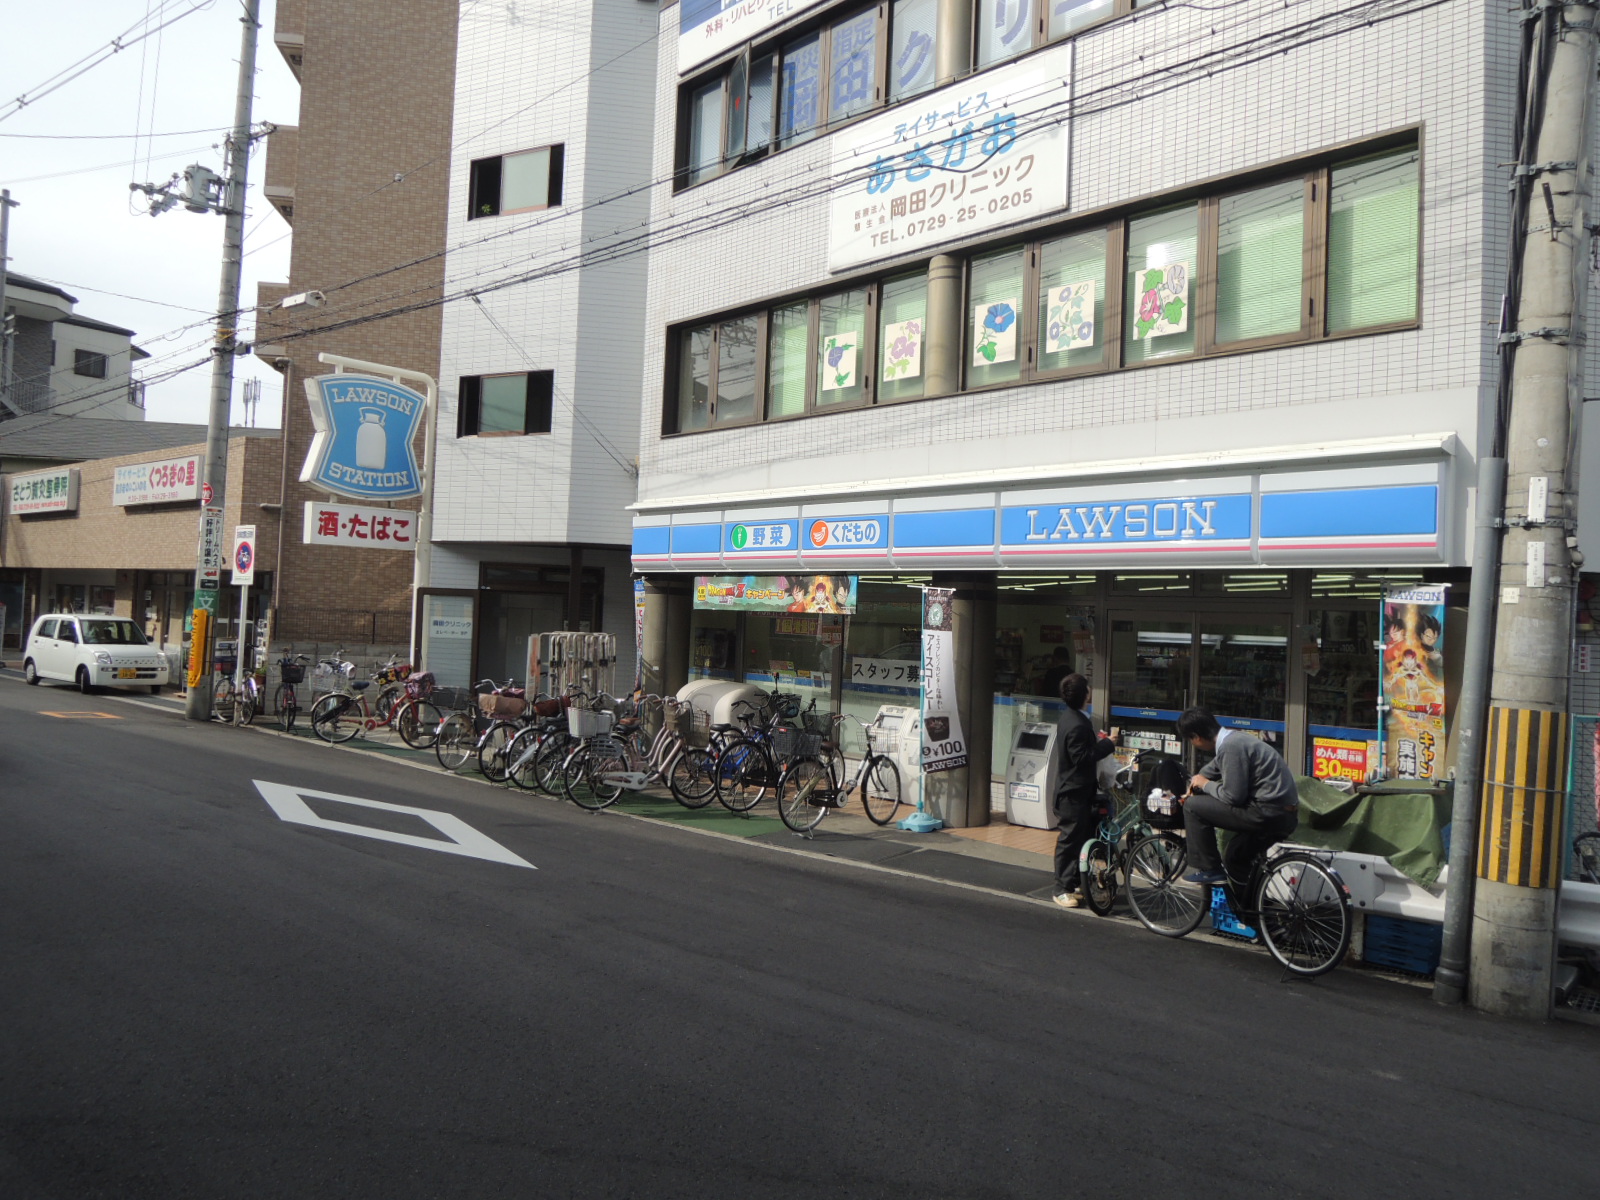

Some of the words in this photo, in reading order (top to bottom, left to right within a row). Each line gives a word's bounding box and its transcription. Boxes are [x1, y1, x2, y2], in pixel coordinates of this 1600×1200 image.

[705, 0, 776, 38] 外科・リハビリ
[894, 92, 989, 143] デイサービス
[866, 112, 1017, 194] あさがお
[890, 154, 1035, 219] 岡田クリニック
[331, 387, 413, 415] LAWSON
[149, 460, 195, 489] くつろぎの里
[329, 461, 409, 487] STATION
[318, 510, 410, 542] 酒・たばこ
[831, 523, 877, 543] くだもの
[1026, 501, 1217, 541] LAWSON
[752, 526, 783, 546] 野菜
[746, 588, 785, 600] キャンペーン
[1388, 589, 1441, 602] LAWSON
[853, 663, 920, 683] スタッフ募
[925, 634, 935, 710] アイスコーヒー
[933, 741, 962, 757] ¥100
[1316, 747, 1348, 760] めん類
[924, 757, 967, 772] LAWSON
